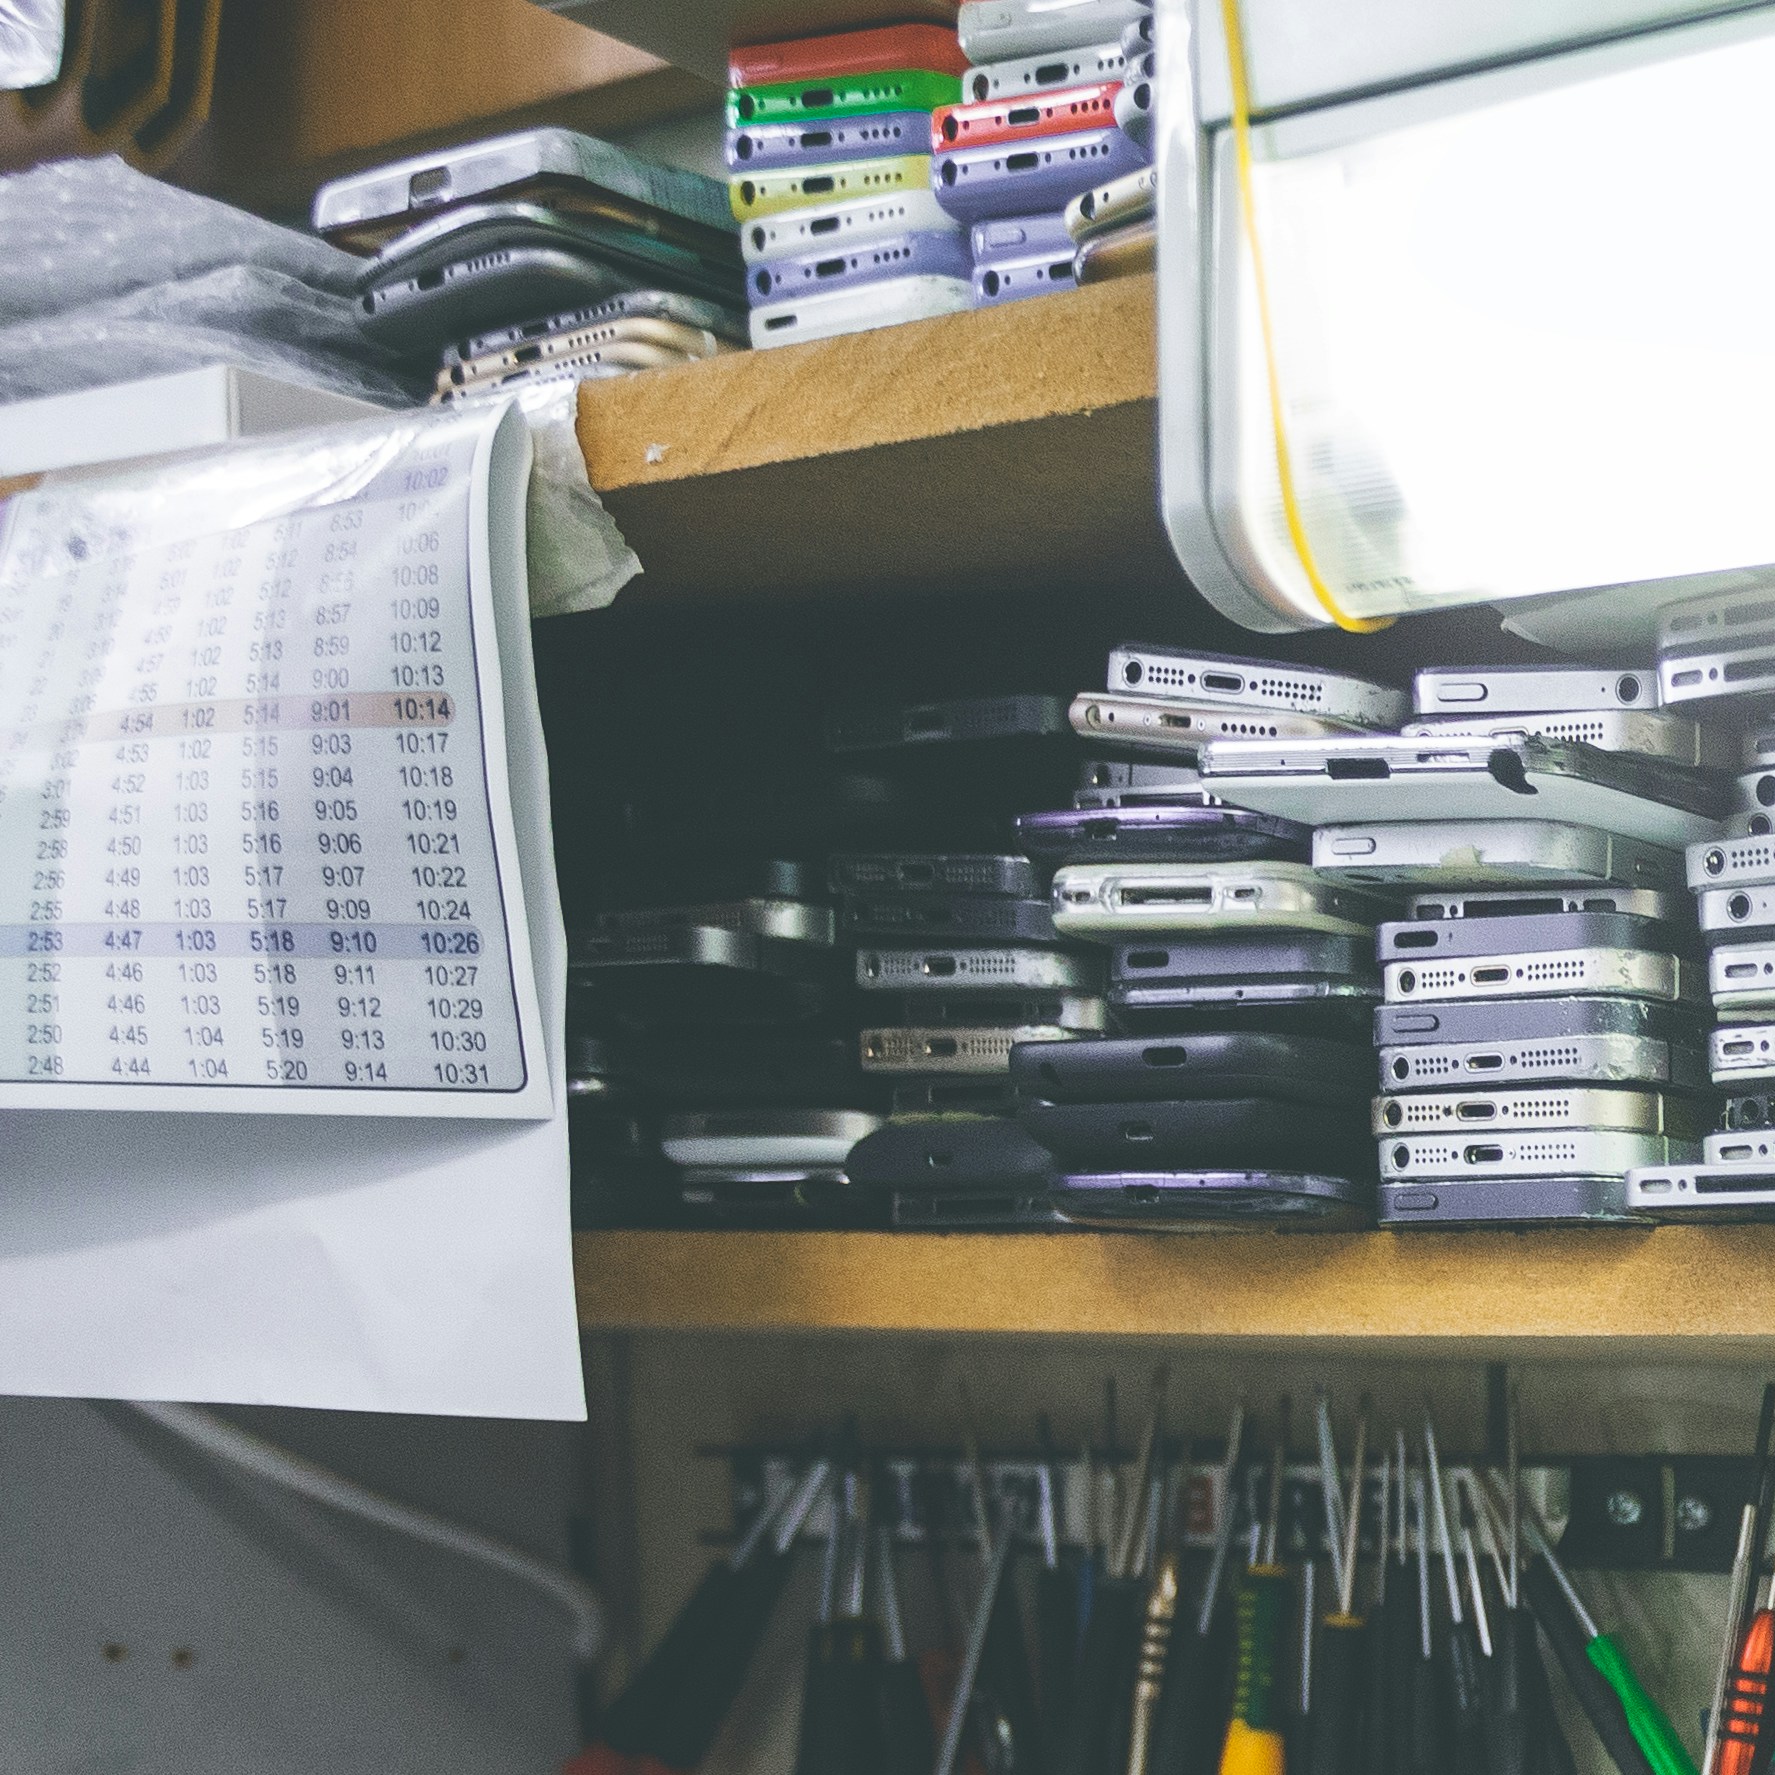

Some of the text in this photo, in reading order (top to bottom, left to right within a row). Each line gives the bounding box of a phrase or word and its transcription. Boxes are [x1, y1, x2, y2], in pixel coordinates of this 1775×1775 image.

[315, 602, 352, 626] 8:57
[390, 597, 441, 621] 10:09
[312, 635, 350, 658] 8:59
[390, 630, 443, 654] 10:12
[311, 667, 350, 691] 9:00
[390, 663, 445, 687] 10:13
[181, 706, 216, 730] 1:02
[243, 702, 281, 726] 5:14
[310, 699, 351, 723] 9:01
[393, 697, 451, 721] 10:14
[178, 738, 213, 761] 1:02
[242, 734, 279, 758] 5:15
[310, 733, 353, 756] 9:03
[395, 732, 450, 755] 10:17
[111, 773, 147, 796] 4:52
[174, 769, 210, 793] 1:03
[240, 767, 279, 791] 5:15
[311, 766, 355, 789] 9:04
[398, 765, 454, 788] 10:18
[107, 804, 143, 826] 4:51
[172, 801, 209, 825] 1:03
[240, 799, 281, 822] 5:16
[314, 798, 359, 822] 9:05
[401, 798, 459, 821] 10:19
[106, 835, 143, 858] 4:50
[172, 832, 209, 857] 1:03
[241, 832, 283, 855] 5:16
[317, 832, 363, 856] 9:06
[405, 832, 462, 855] 10:21
[104, 867, 142, 889] 4:49
[171, 865, 211, 889] 1:03
[243, 865, 285, 888] 5:17
[321, 865, 366, 888] 9:07
[410, 865, 468, 889] 10:22
[103, 898, 142, 920] 4:48
[172, 897, 213, 921] 1:03
[246, 897, 288, 921] 5:17
[325, 898, 372, 921] 9:09
[415, 898, 473, 922] 10:24
[28, 929, 482, 955] 2:53 4:47 1:03 5:18 9:10 10:26
[26, 961, 480, 987] 2:52 4:46 1:03 5:18 9:11 10:27
[26, 993, 484, 1020] 2:51 4:46 1:03 5:19 9:12 10:29
[26, 1024, 488, 1053] 2:50 4:45 1:04 5:19 9:13 10:30
[27, 1055, 490, 1086] 2:48 4:44 1:04 5:20 9:14 10:31
